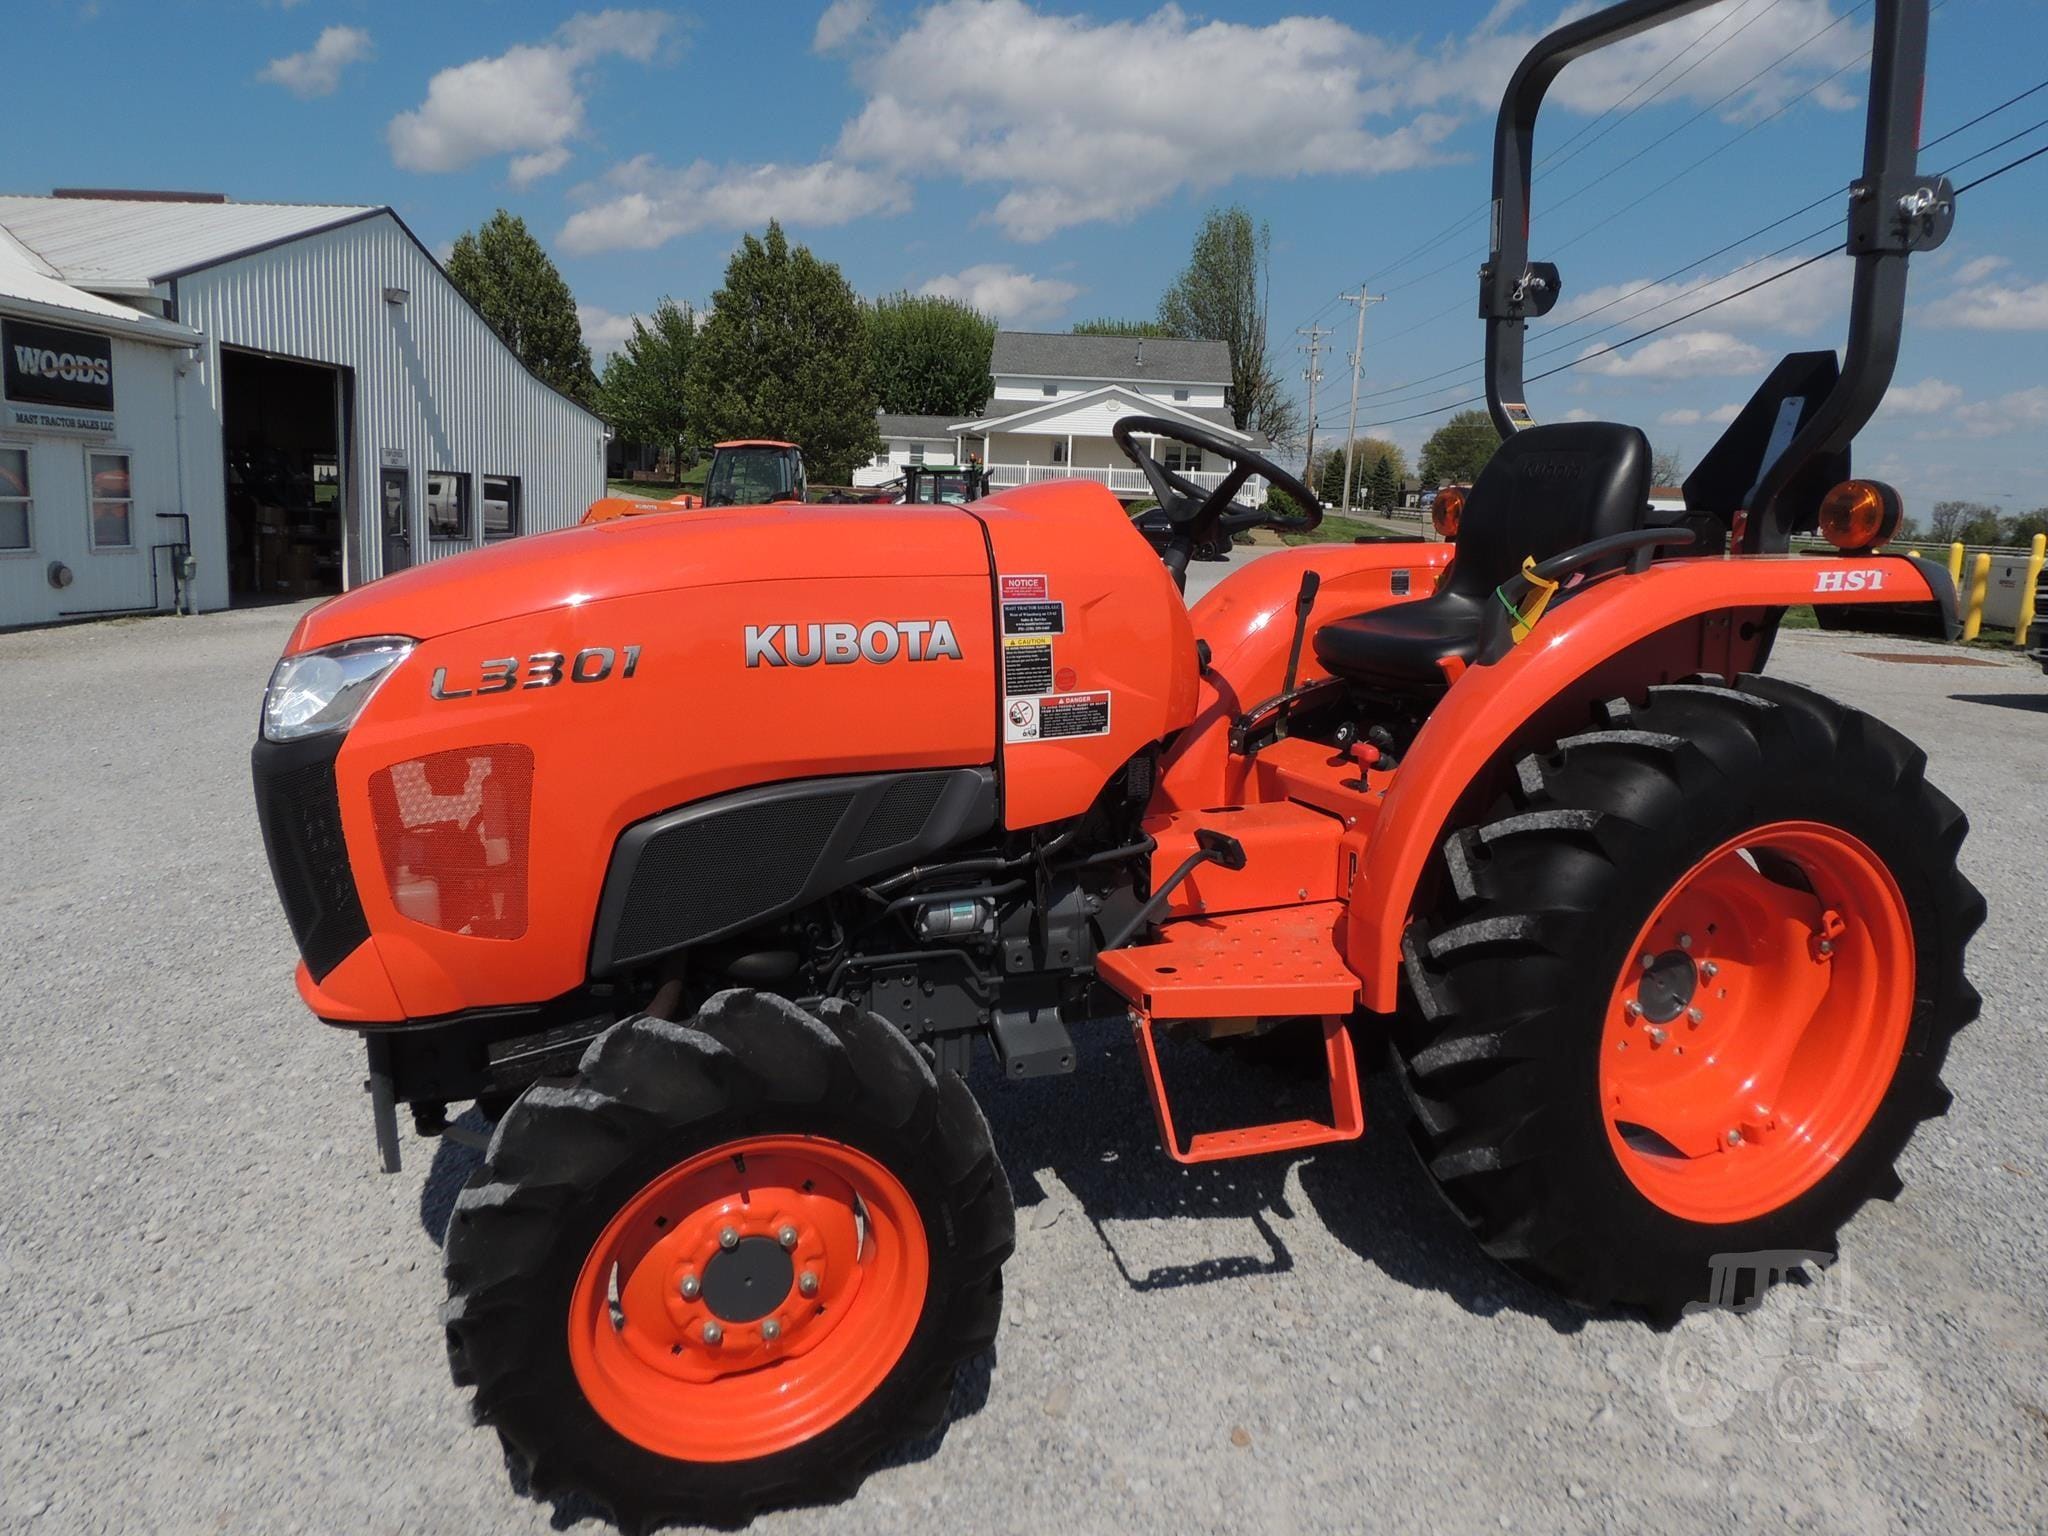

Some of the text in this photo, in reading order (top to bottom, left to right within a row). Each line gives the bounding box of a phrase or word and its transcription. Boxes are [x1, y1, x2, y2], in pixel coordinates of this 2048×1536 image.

[14, 345, 109, 386] WOODS
[15, 412, 114, 432] MAST TRACTOR SALES LLC
[1008, 579, 1039, 587] NOTICE
[1813, 569, 1883, 592] HST
[744, 620, 962, 669] KUBOTA
[430, 645, 643, 701] L3301
